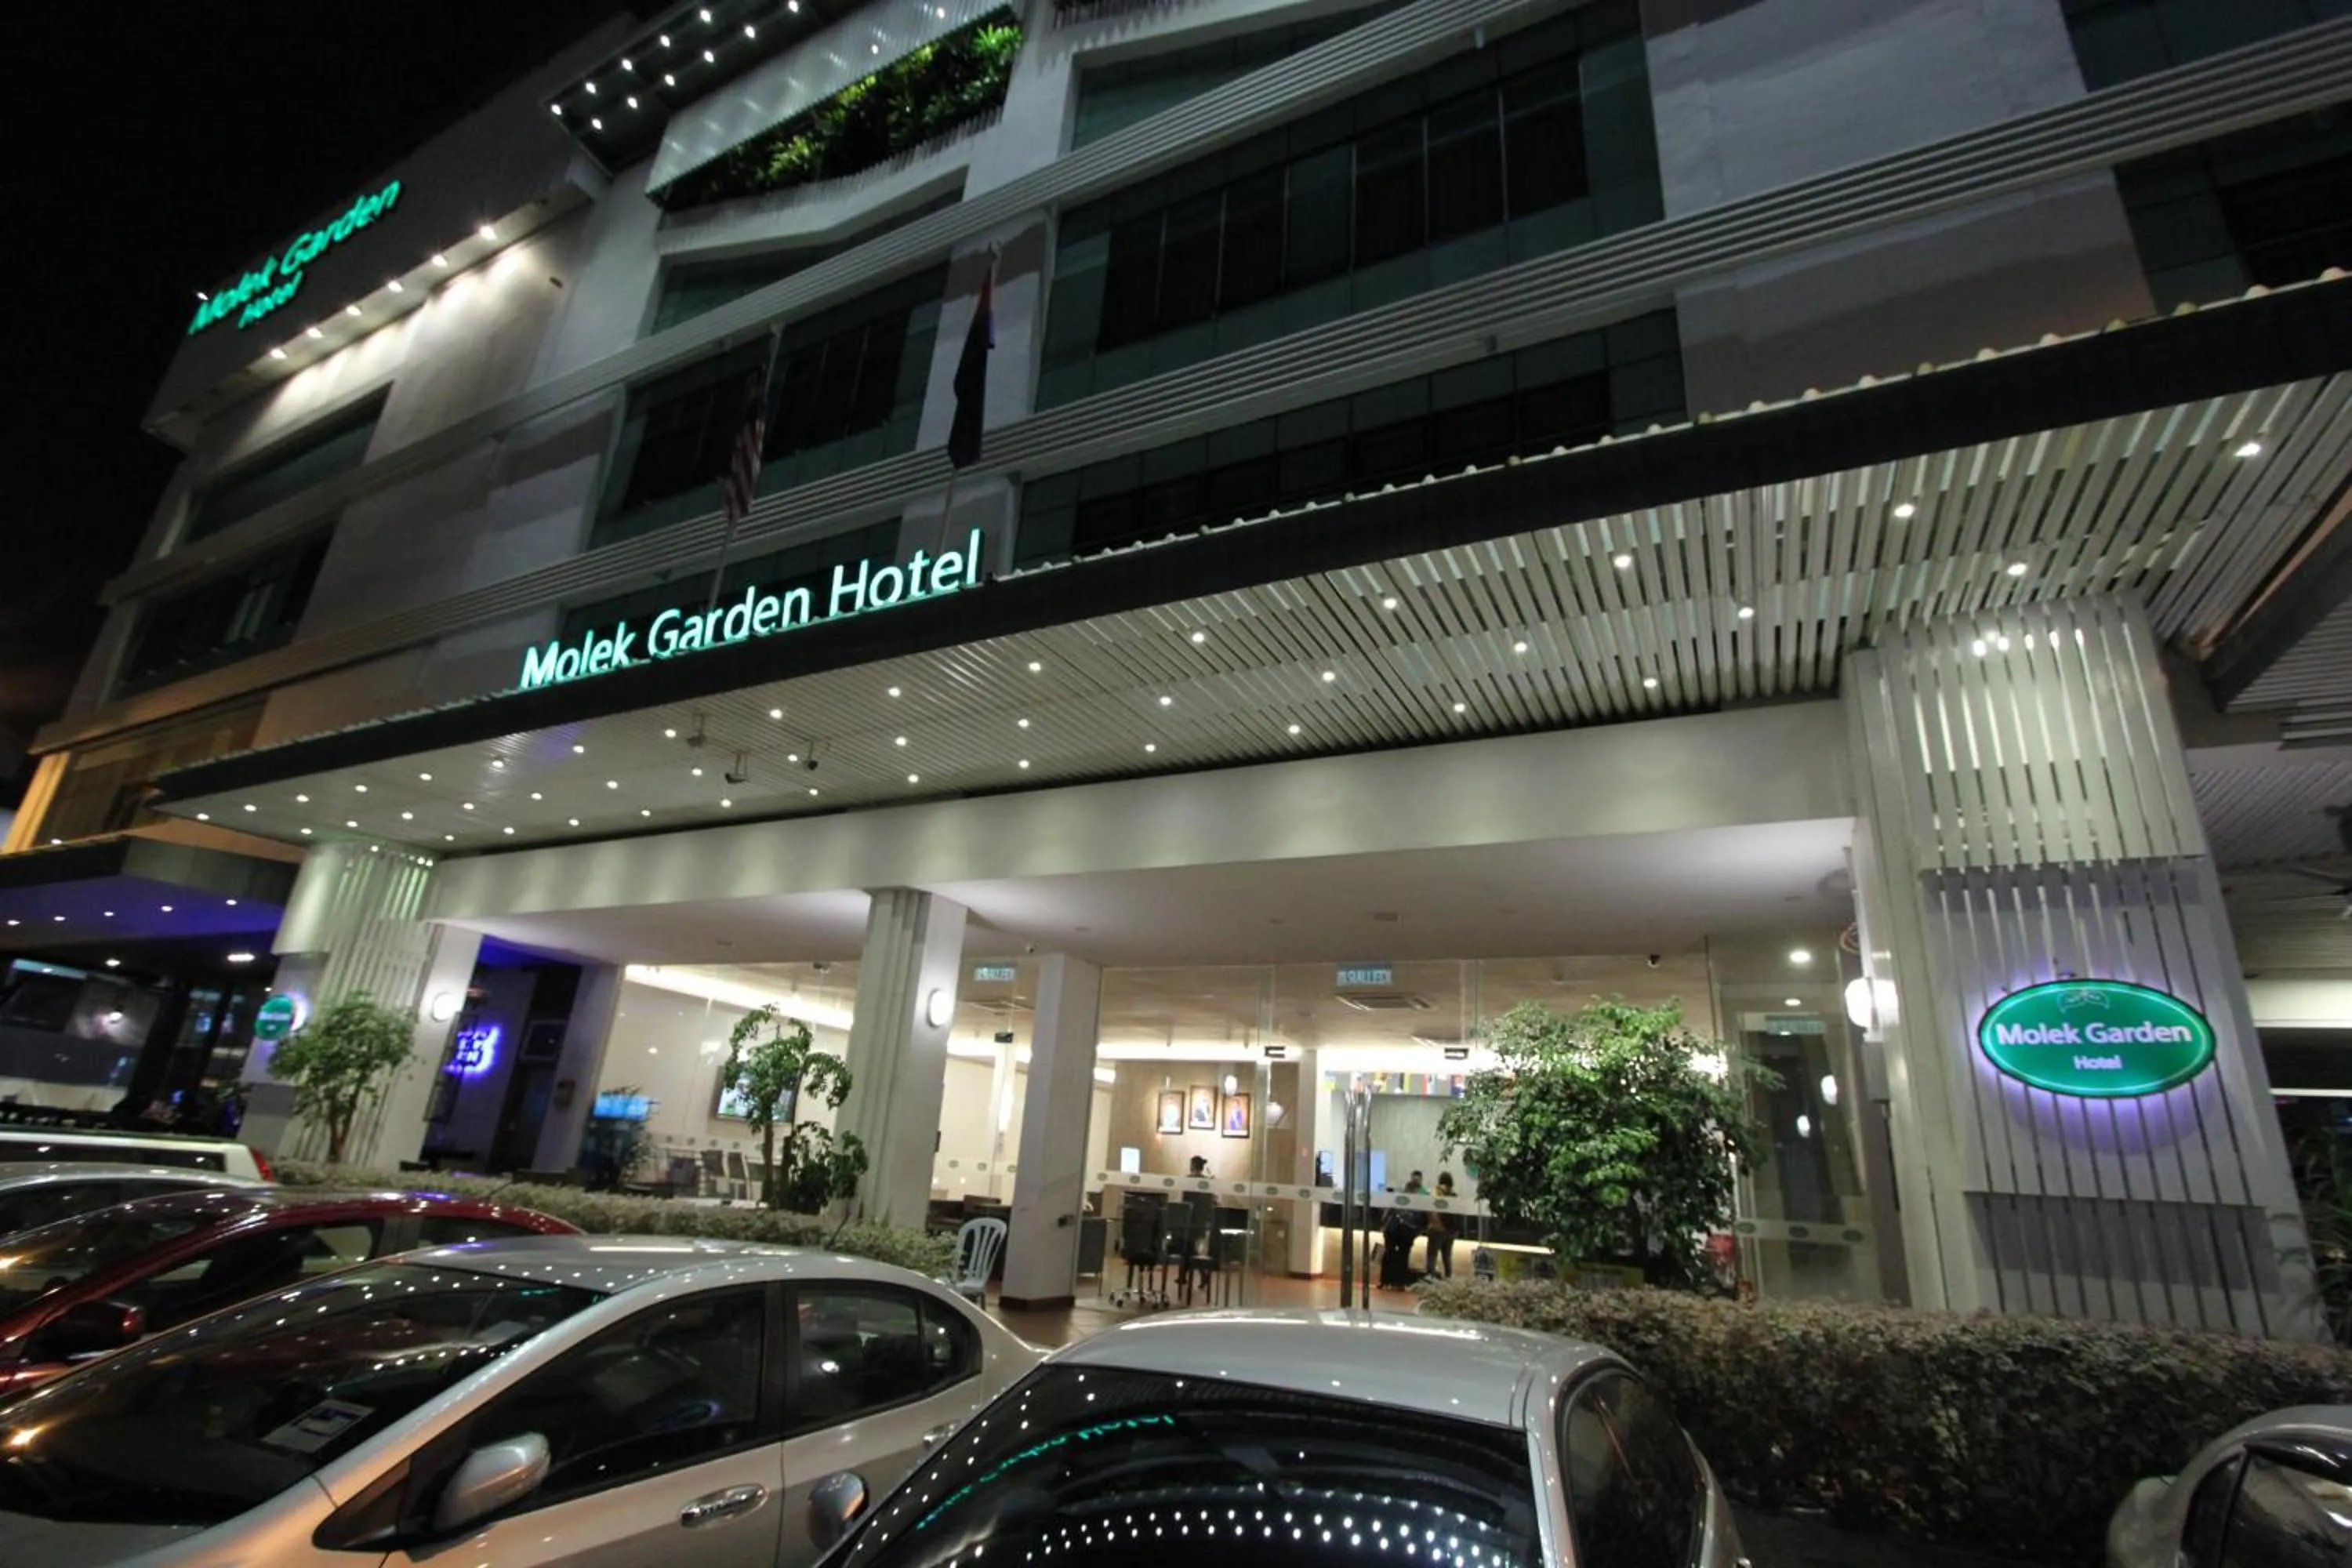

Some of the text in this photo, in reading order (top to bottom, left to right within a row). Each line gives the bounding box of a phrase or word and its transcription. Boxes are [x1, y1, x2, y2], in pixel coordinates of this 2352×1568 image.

[280, 180, 401, 275] Garden
[520, 528, 982, 689] Molek Garden Hotel
[1996, 1021, 2192, 1044] Molek Garden
[2074, 1055, 2122, 1069] Hotel
